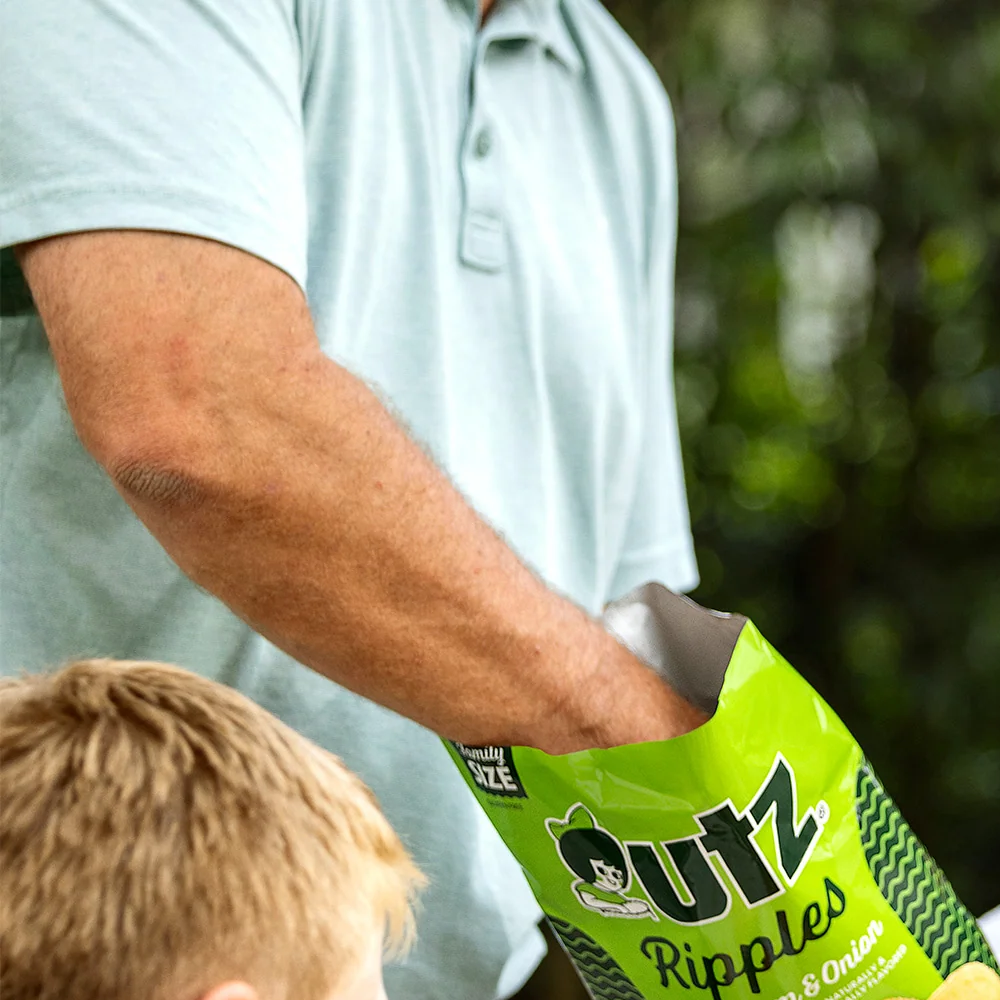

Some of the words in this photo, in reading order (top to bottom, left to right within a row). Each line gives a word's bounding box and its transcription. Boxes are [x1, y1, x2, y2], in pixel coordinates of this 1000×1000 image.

[467, 759, 518, 791] SIZE
[801, 972, 820, 997] &
[821, 919, 885, 985] Onion
